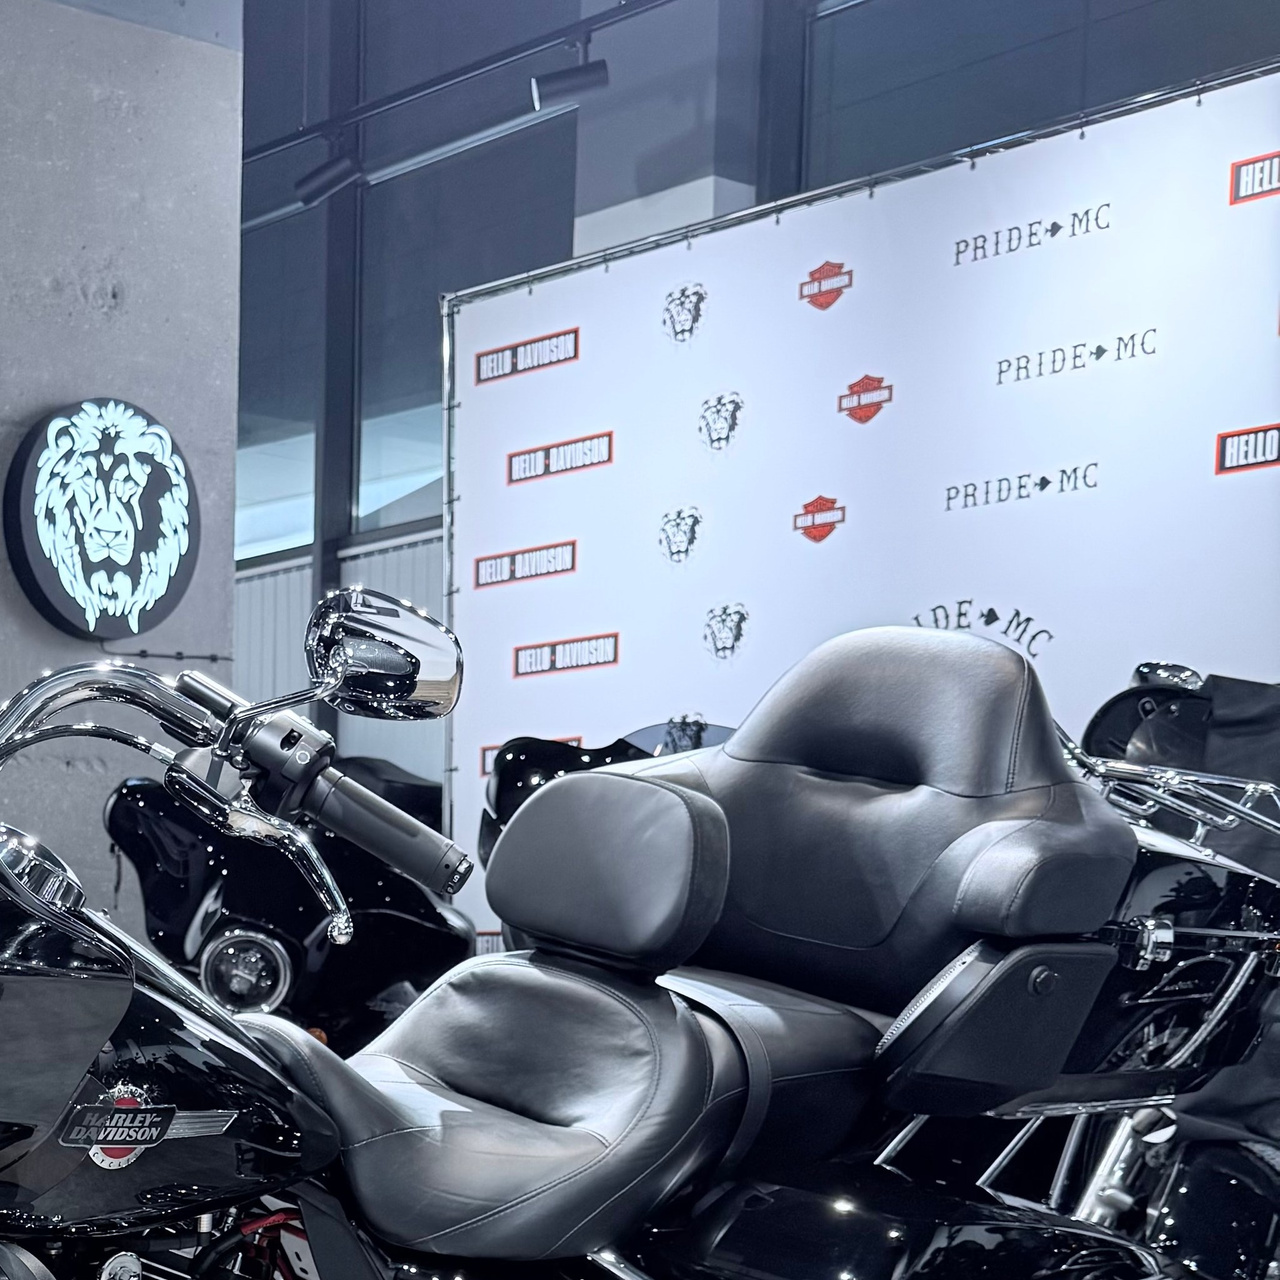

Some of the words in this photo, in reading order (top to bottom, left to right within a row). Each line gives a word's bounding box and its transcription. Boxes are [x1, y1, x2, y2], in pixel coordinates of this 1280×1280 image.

[1239, 157, 1280, 197] HELL
[953, 219, 1043, 267] PRIDE
[1068, 203, 1112, 238] MC
[480, 350, 512, 380] HELLO
[517, 332, 575, 370] DAVIDSON
[996, 342, 1088, 385] PRIDE
[1114, 328, 1158, 362] MC
[512, 451, 545, 481] HELLO
[549, 436, 610, 472] DAVIDSON
[1224, 428, 1279, 468] HELLO
[944, 473, 1032, 512] PRIDE
[1057, 462, 1099, 494] MC
[478, 556, 511, 585] HELLO
[515, 544, 573, 578] DAVIDSON
[518, 646, 551, 674] HELLO
[555, 636, 615, 669] DAVIDSON
[1000, 608, 1055, 659] MC
[69, 1126, 162, 1142] DAVIDSON
